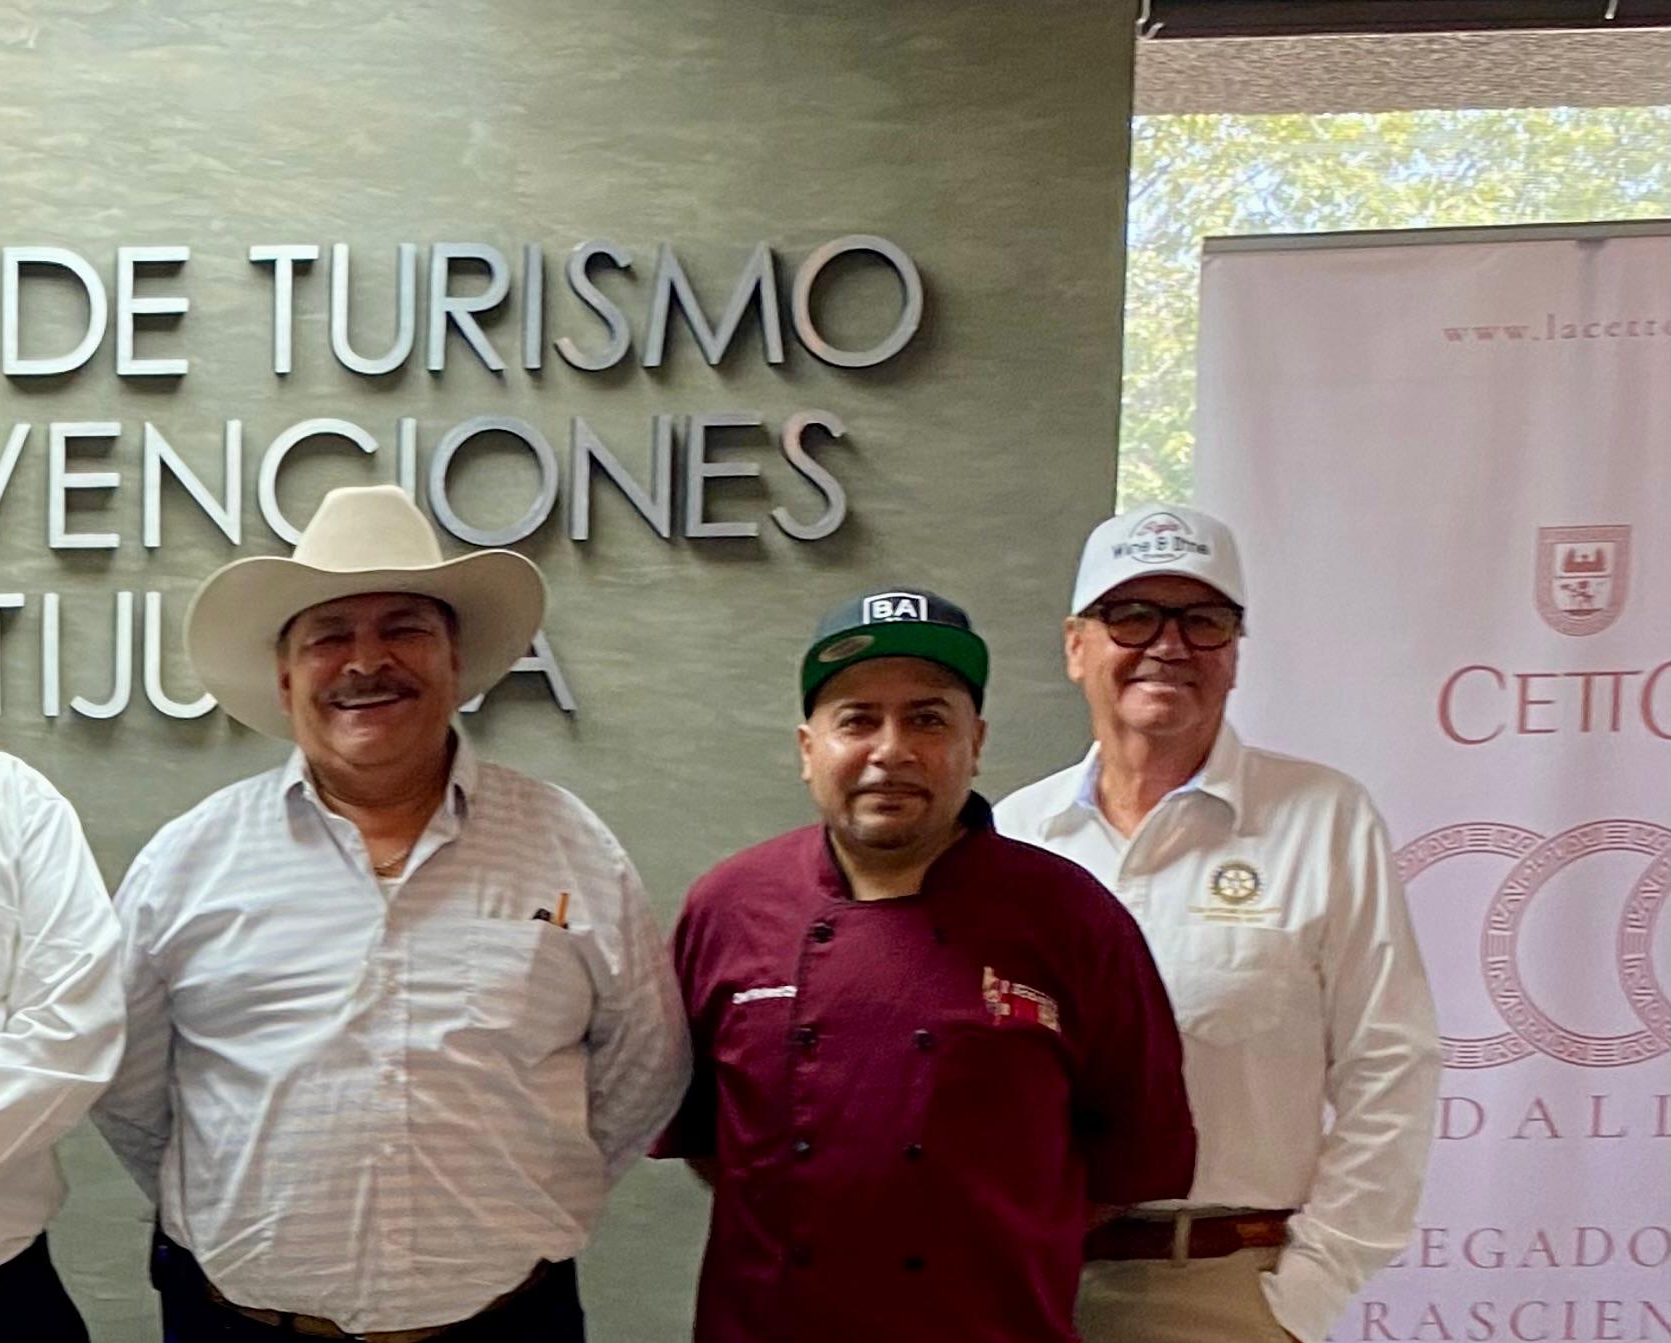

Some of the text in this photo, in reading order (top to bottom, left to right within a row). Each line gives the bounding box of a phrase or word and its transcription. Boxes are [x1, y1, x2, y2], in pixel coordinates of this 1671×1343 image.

[2, 246, 190, 376] DE
[249, 234, 923, 377] TURISMO
[872, 599, 918, 619] BA
[1384, 1225, 1671, 1268] EGADO
[1325, 1300, 1671, 1342] RASCIEN
